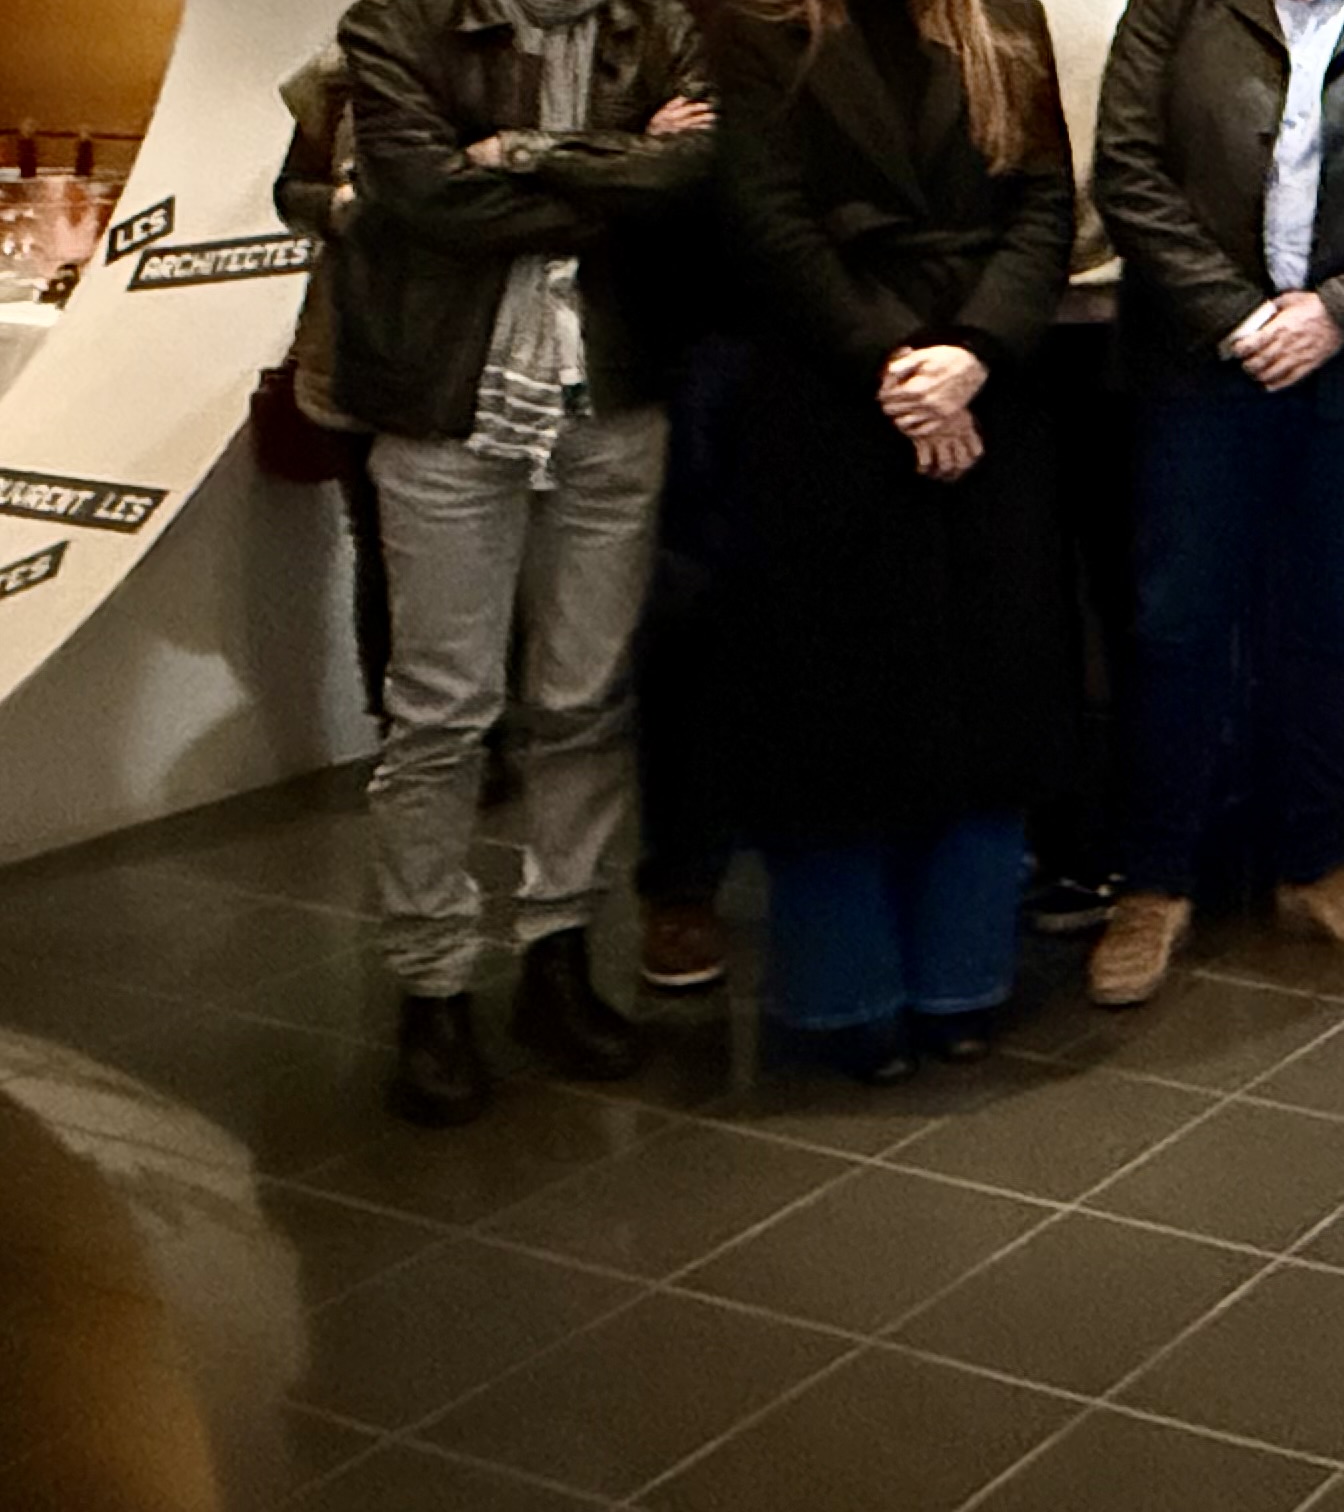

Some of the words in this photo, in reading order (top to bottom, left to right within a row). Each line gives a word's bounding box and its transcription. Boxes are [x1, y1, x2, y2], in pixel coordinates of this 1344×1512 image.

[115, 206, 168, 252] LES
[138, 236, 313, 282] ARCHITECTES
[92, 490, 154, 523] LES
